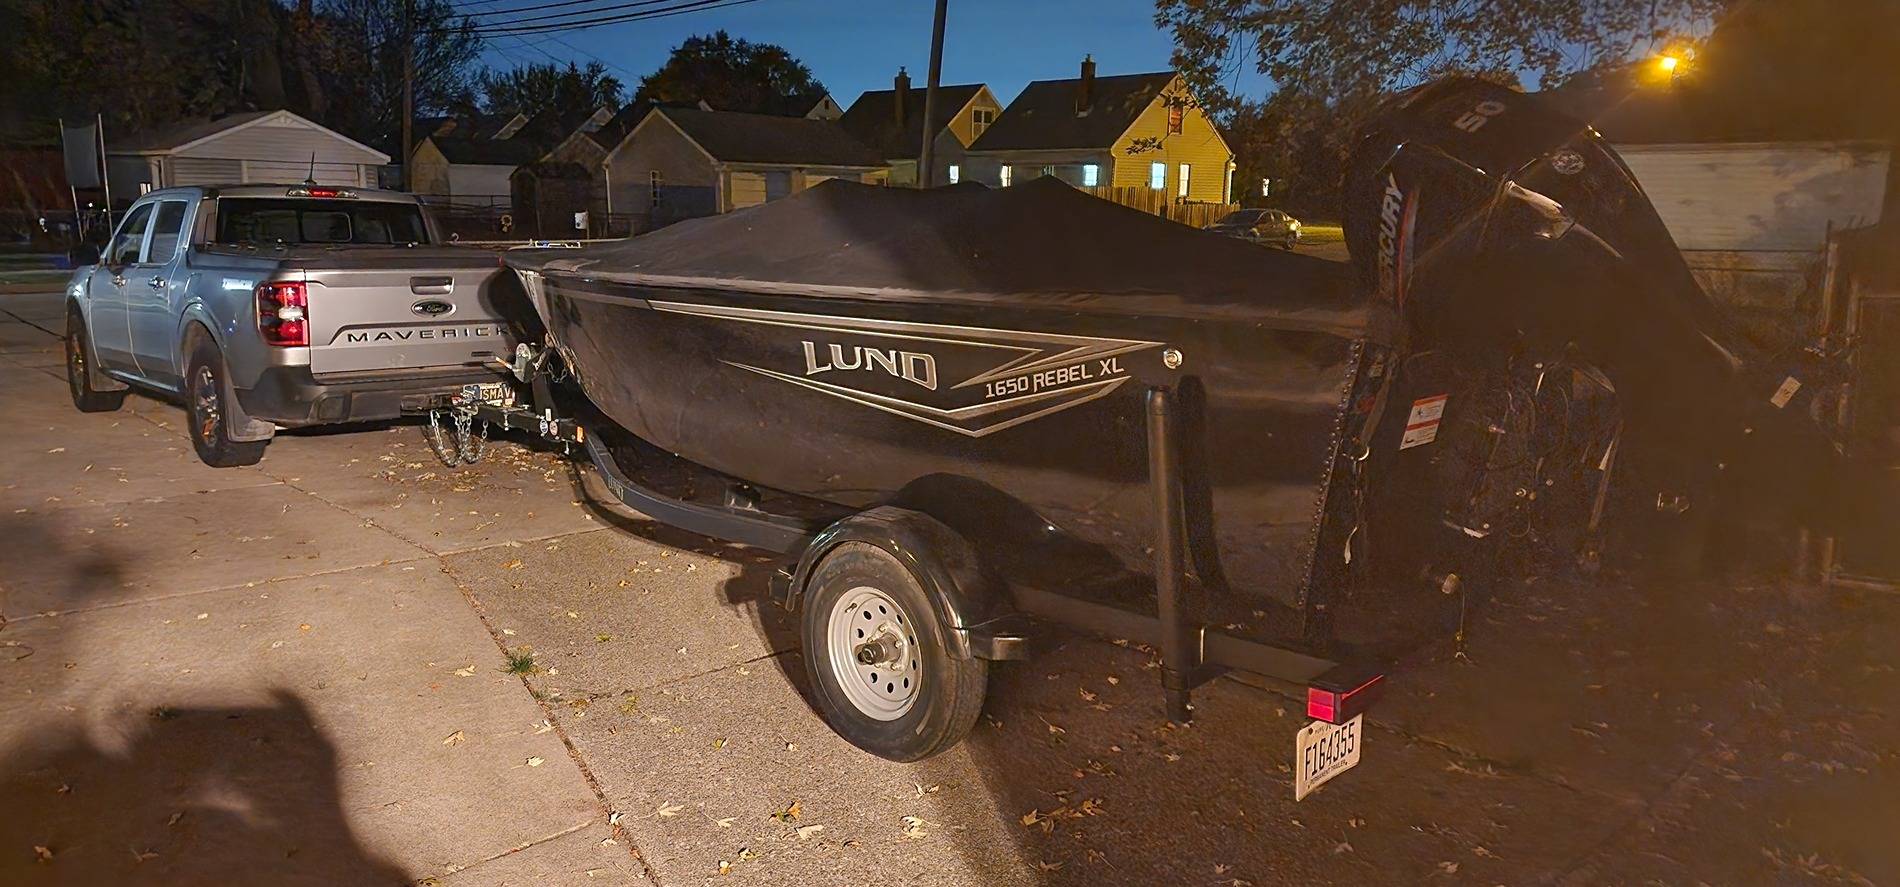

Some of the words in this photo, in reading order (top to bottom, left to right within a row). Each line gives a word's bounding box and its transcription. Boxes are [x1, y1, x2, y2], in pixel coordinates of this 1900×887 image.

[1455, 101, 1505, 132] 50
[1378, 172, 1403, 292] ERCURY
[423, 302, 448, 313] Ford
[347, 325, 508, 343] MAVERICK
[801, 340, 937, 391] LUND
[985, 376, 1029, 398] 1650
[1033, 364, 1093, 392] REBEL
[1100, 357, 1124, 376] XL
[1305, 721, 1355, 781] F164355
